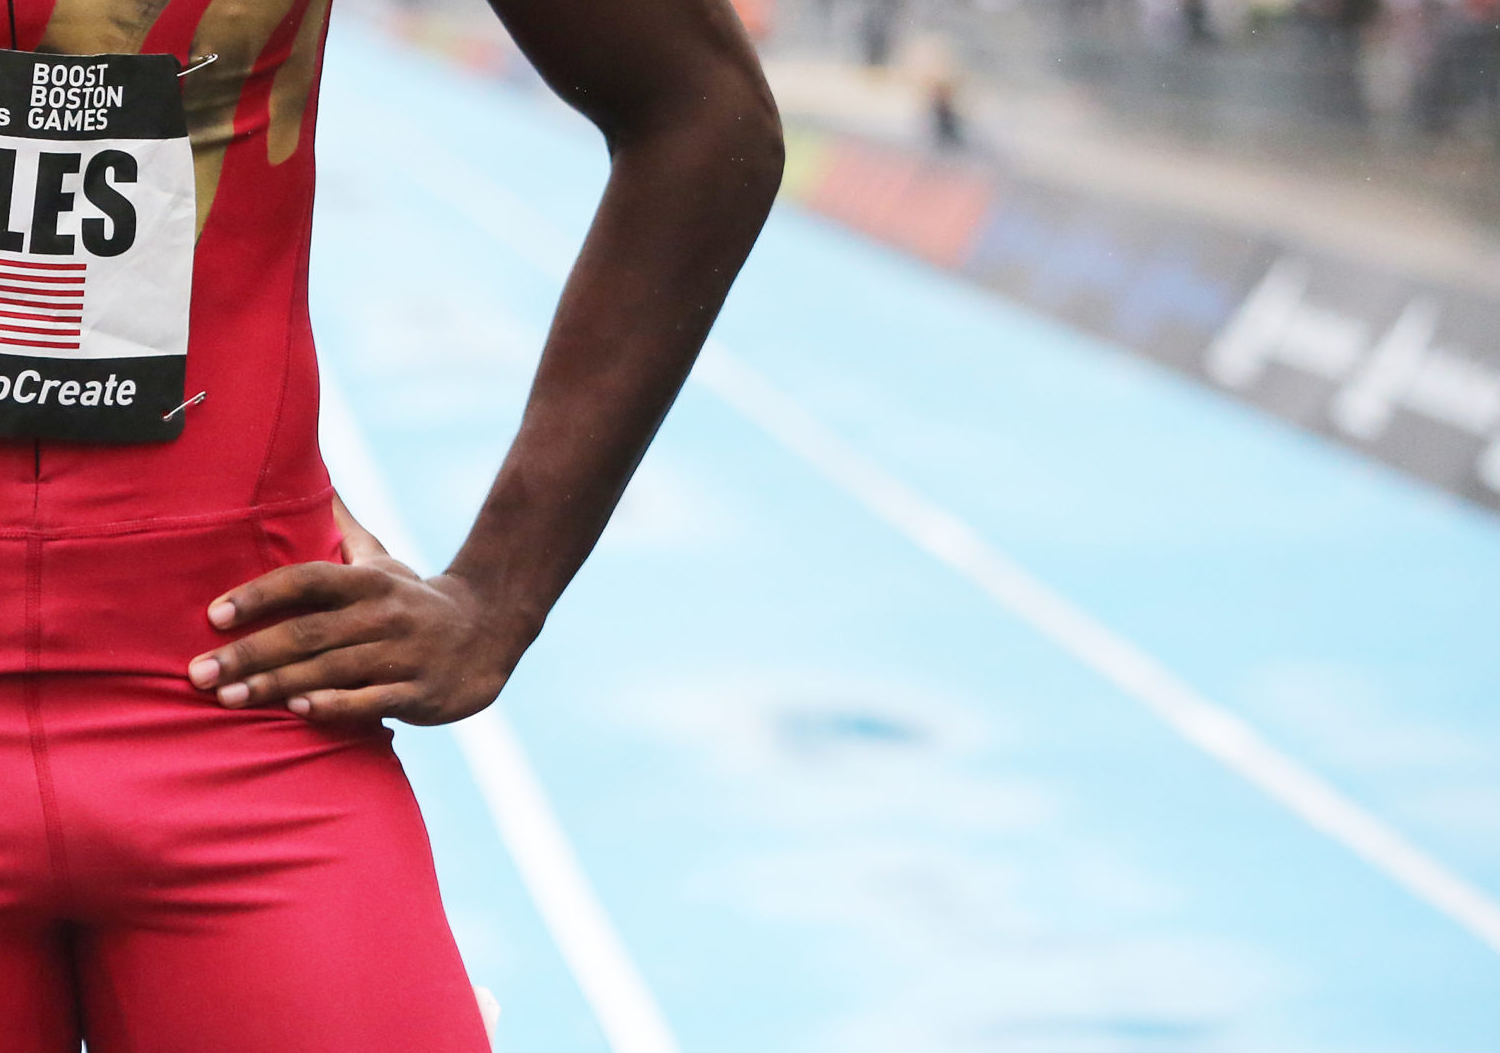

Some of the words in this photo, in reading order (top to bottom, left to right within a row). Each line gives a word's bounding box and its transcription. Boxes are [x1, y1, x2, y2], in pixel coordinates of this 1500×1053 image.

[32, 63, 108, 86] BOOST
[29, 85, 123, 109] BOSTON
[27, 108, 108, 131] GAMES
